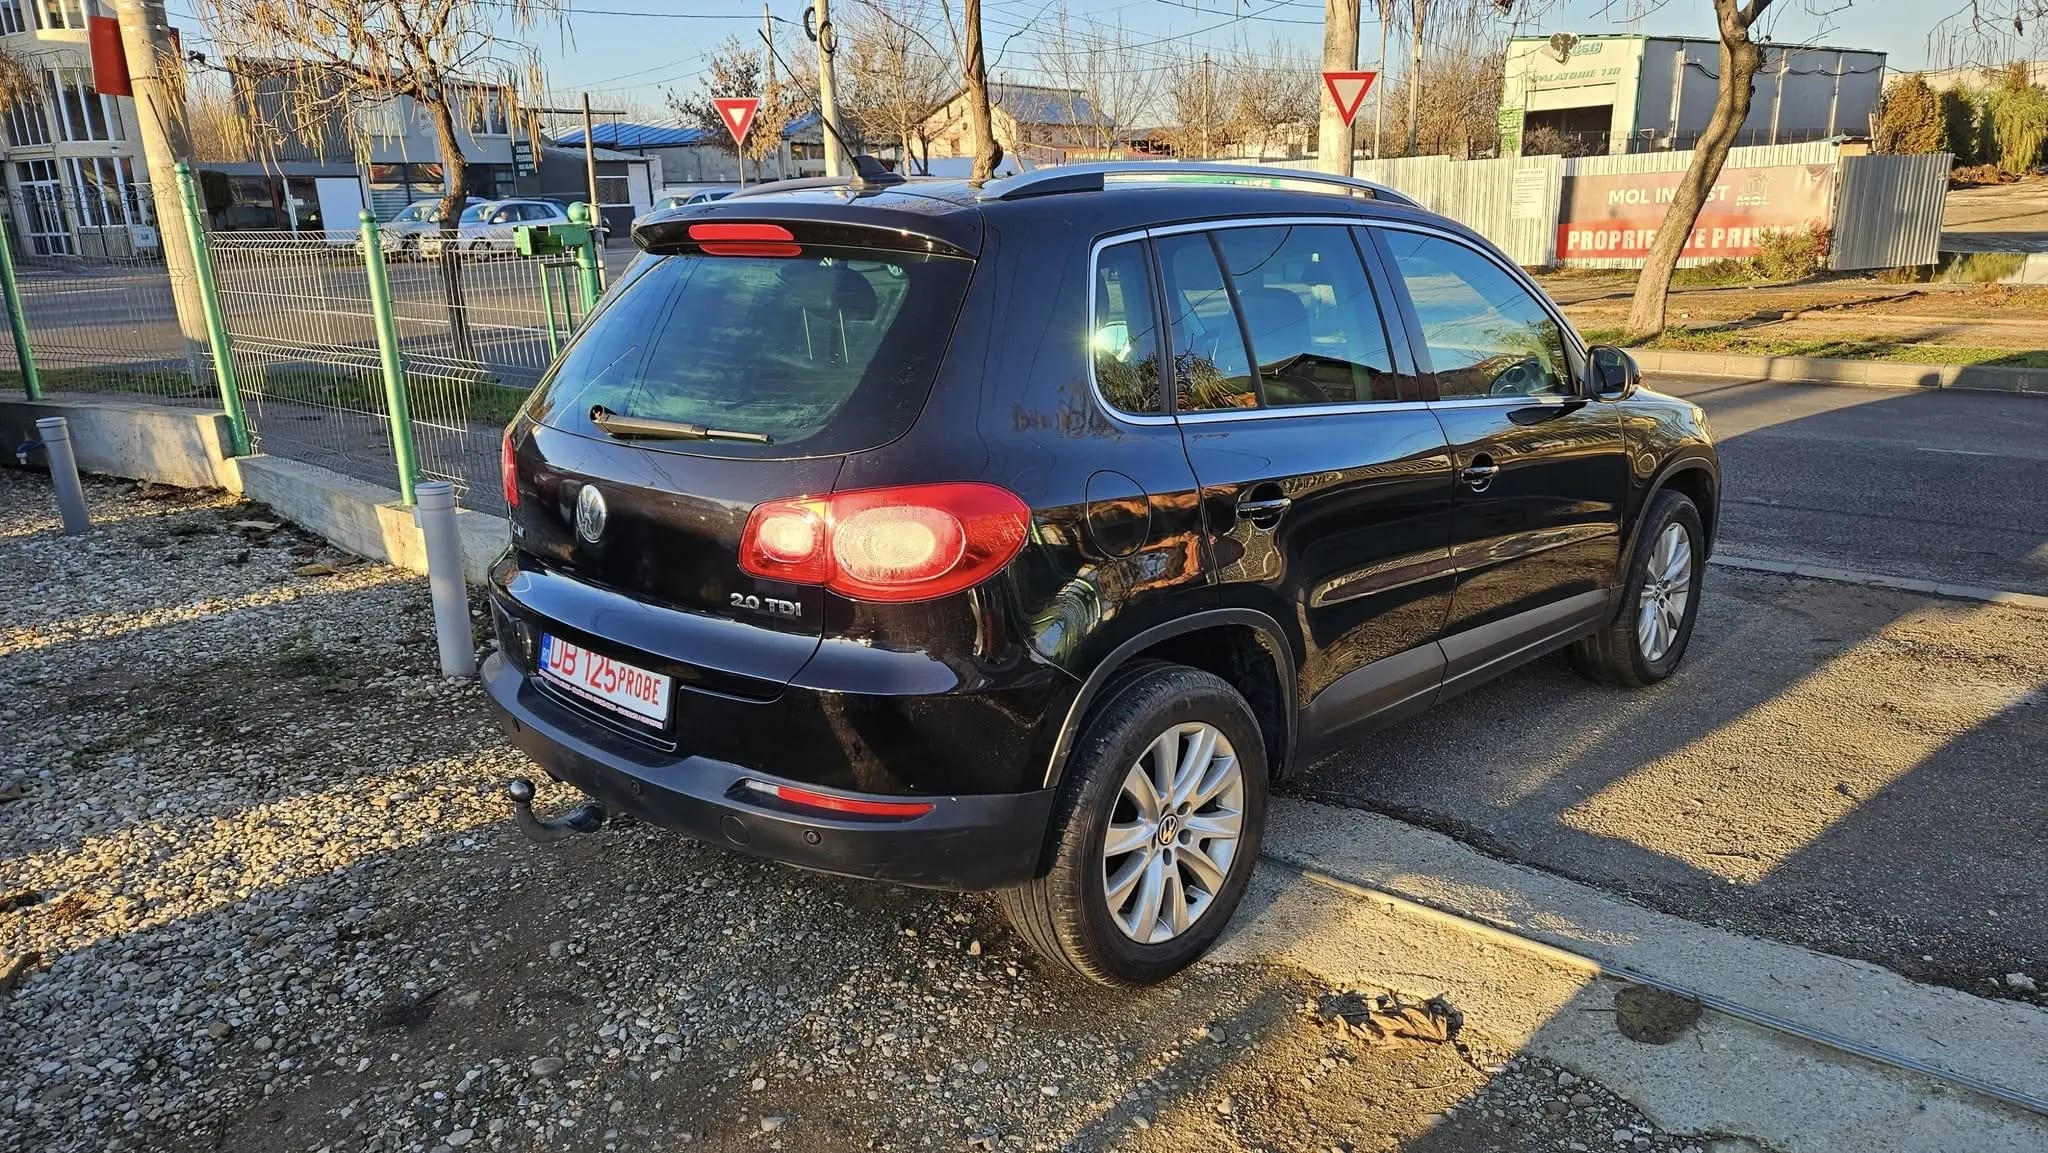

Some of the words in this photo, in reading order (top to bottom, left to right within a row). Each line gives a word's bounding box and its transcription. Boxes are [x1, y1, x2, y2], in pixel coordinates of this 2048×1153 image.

[1608, 187, 1650, 205] MOL
[1656, 185, 1731, 204] INST
[764, 598, 802, 617] TDI
[550, 637, 578, 676] DB
[585, 649, 617, 693] 125
[617, 667, 662, 706] PROBE
